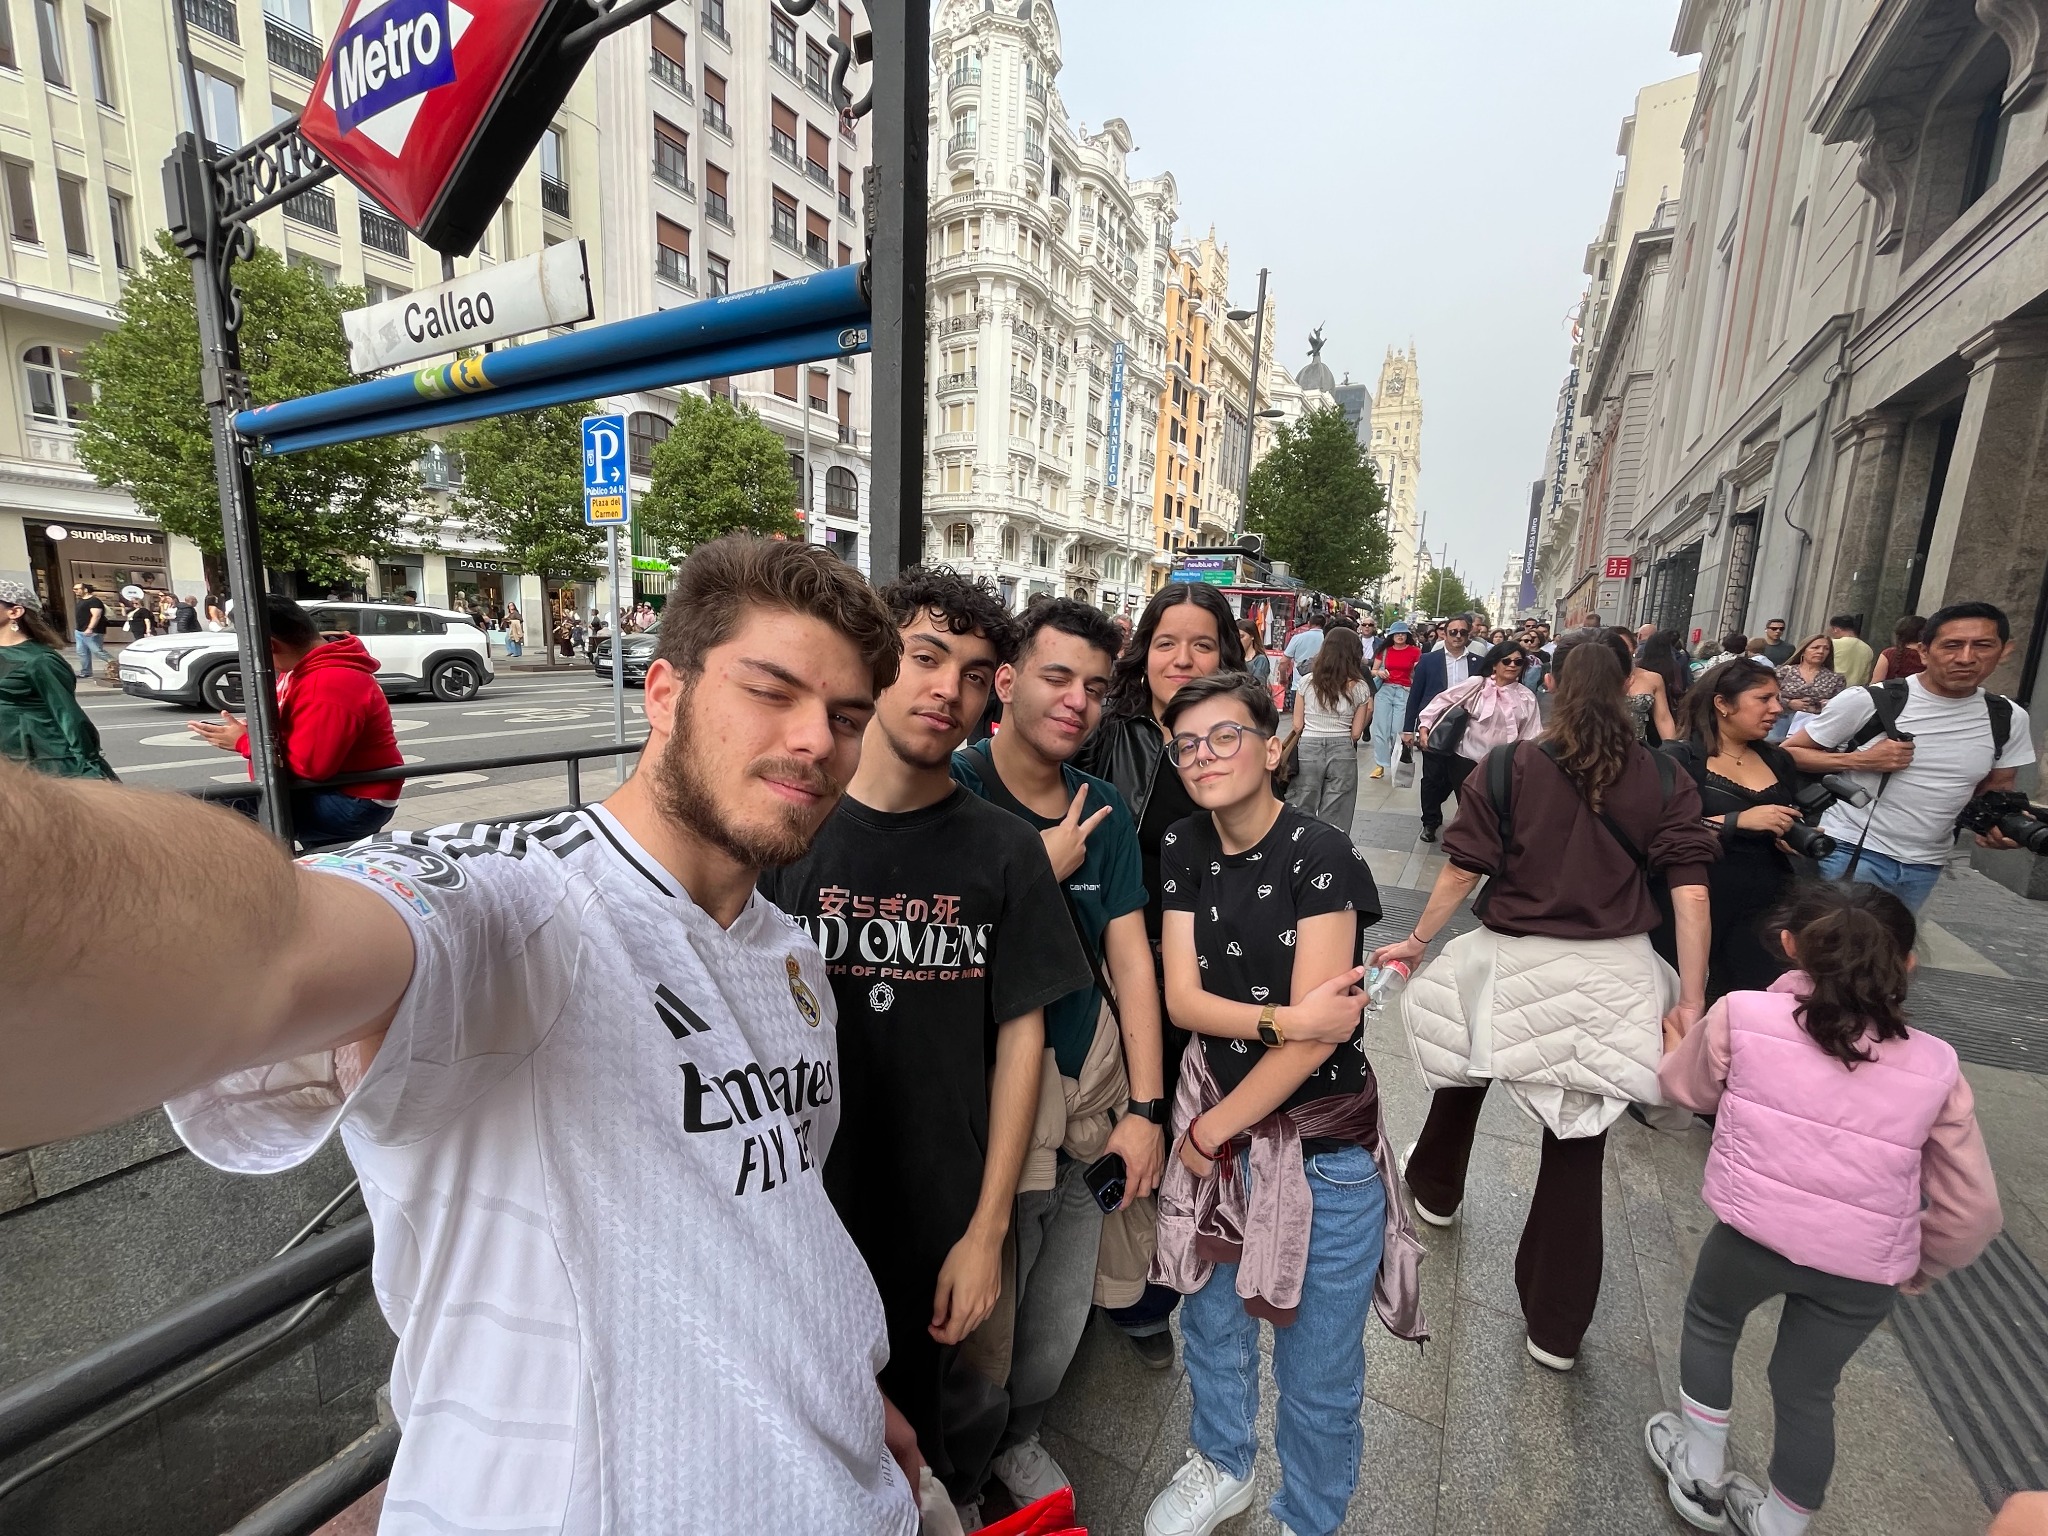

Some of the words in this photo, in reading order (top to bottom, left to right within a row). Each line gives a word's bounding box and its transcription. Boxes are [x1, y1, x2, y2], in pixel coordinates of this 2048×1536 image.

[339, 12, 440, 110] Metro
[717, 290, 754, 303] molestias
[755, 287, 767, 295] las
[769, 277, 809, 289] Disculpen
[404, 291, 495, 343] Callao
[1114, 344, 1123, 392] HOTEL
[590, 429, 619, 484] P
[1108, 398, 1120, 483] ATLANTICO
[586, 487, 608, 496] Público
[609, 486, 617, 495] 24
[592, 498, 609, 507] Plaza
[610, 497, 621, 506] del
[595, 510, 619, 518] Carmen
[71, 530, 128, 543] sunglass
[130, 532, 153, 544] hut
[1525, 548, 1535, 574] Galaxy
[1530, 517, 1538, 535] Ultra
[818, 884, 961, 928] 安らぎの死
[859, 918, 993, 967] OMENS
[851, 965, 876, 977] OF
[880, 967, 936, 981] PEACE
[939, 970, 960, 981] OF
[961, 968, 986, 979] MIN
[679, 1053, 834, 1133] Emates
[735, 1124, 787, 1196] FLY
